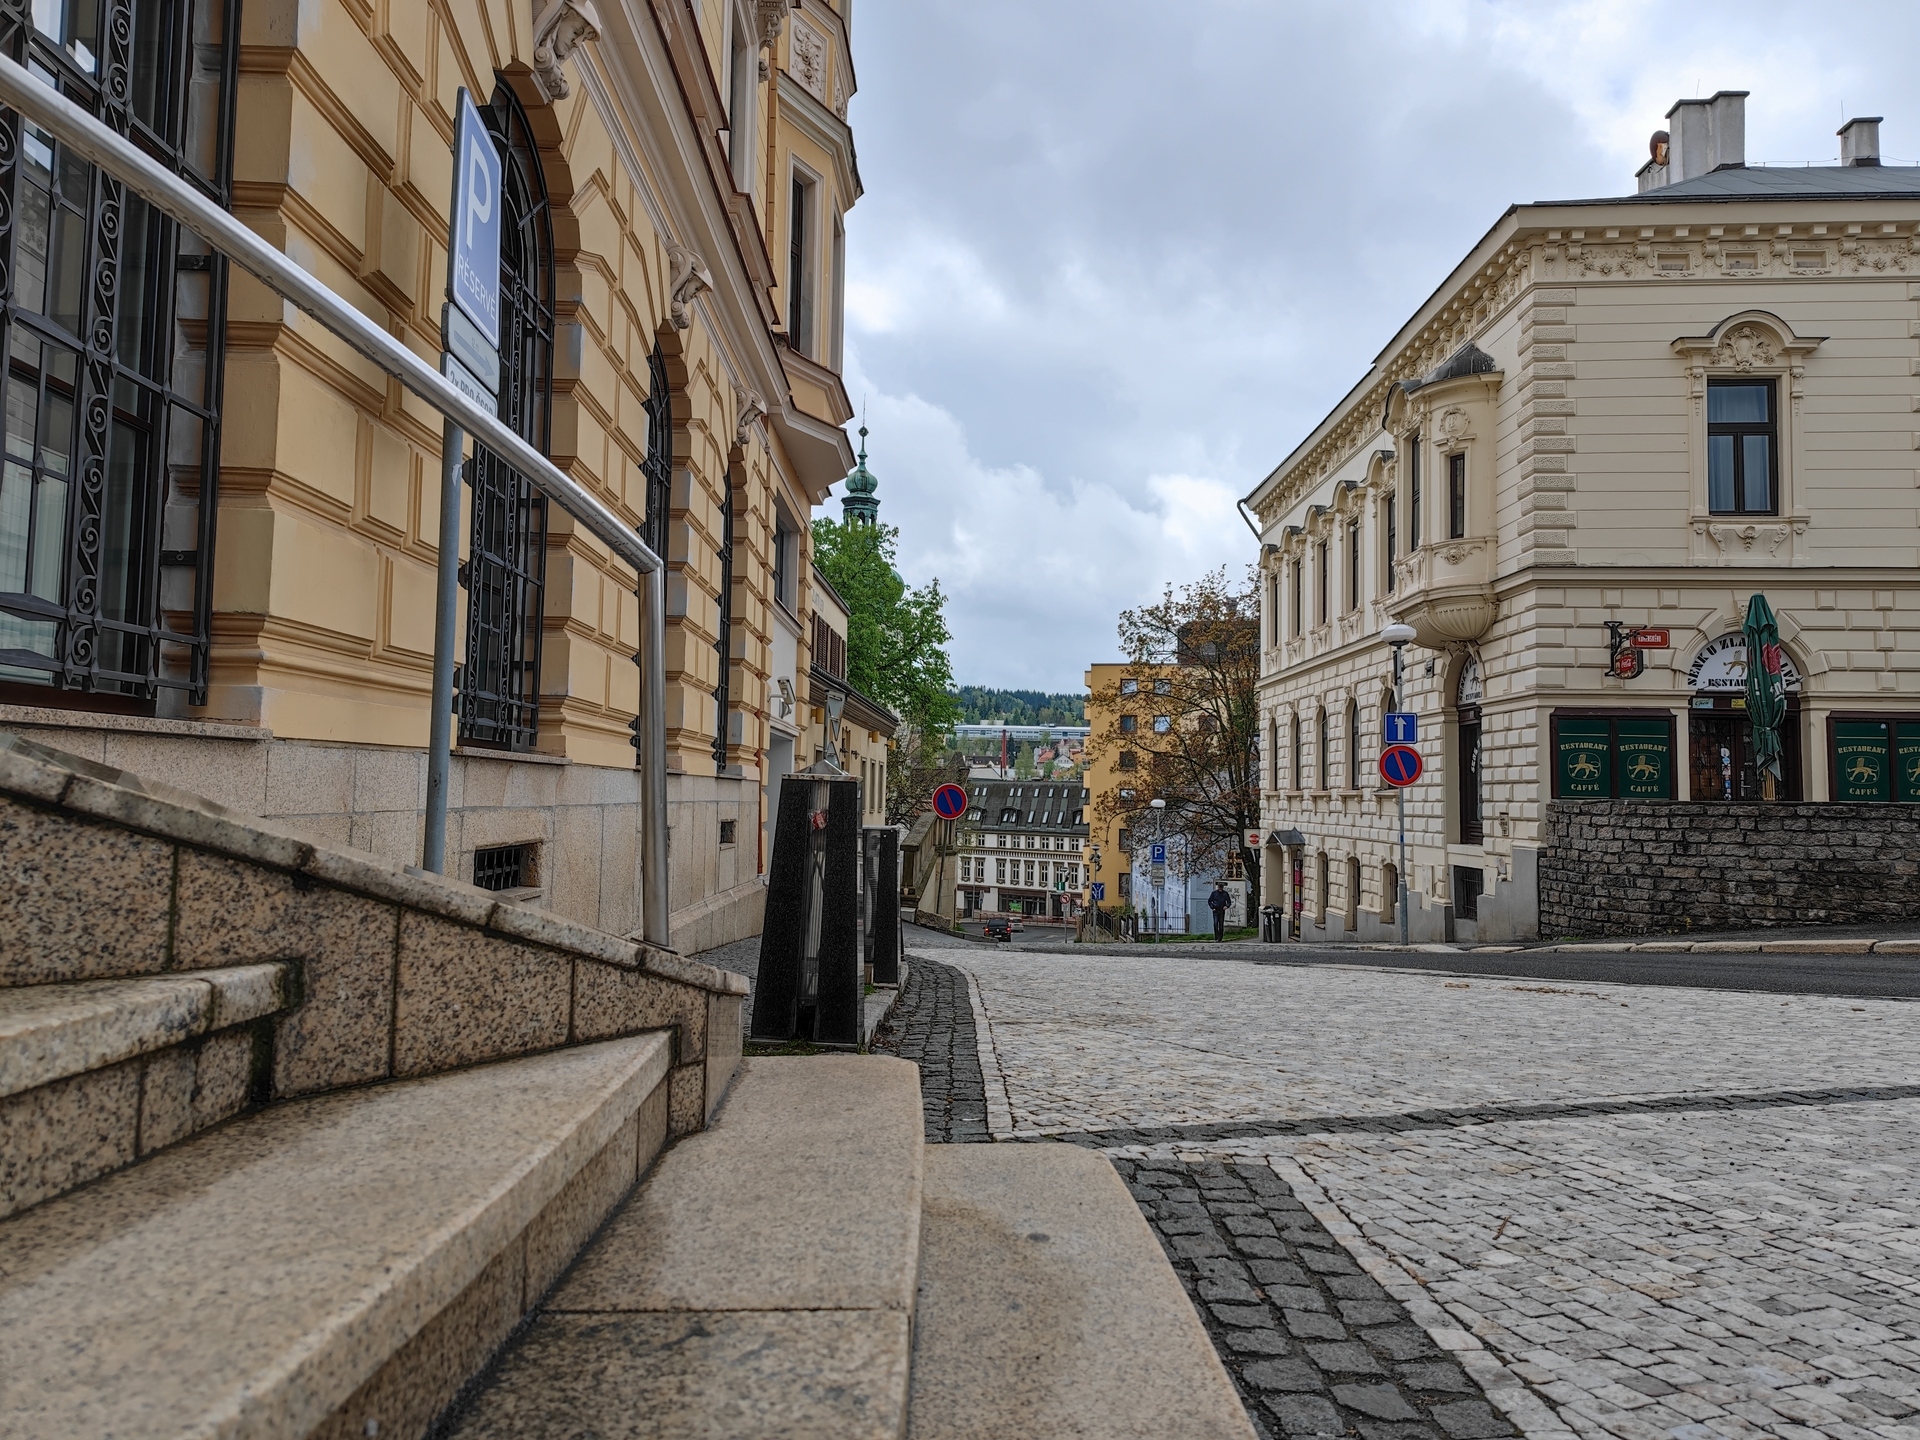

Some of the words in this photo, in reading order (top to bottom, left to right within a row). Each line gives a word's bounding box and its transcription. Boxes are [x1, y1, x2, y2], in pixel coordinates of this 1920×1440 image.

[466, 134, 492, 250] P
[458, 253, 496, 321] RÉSERVÉ
[1706, 645, 1717, 656] U
[1708, 678, 1748, 687] RESTAU
[1560, 742, 1608, 751] RESTAURANT
[1620, 743, 1667, 752] RESTAURANT
[1838, 745, 1887, 754] RESTAURANT
[1154, 846, 1163, 858] P
